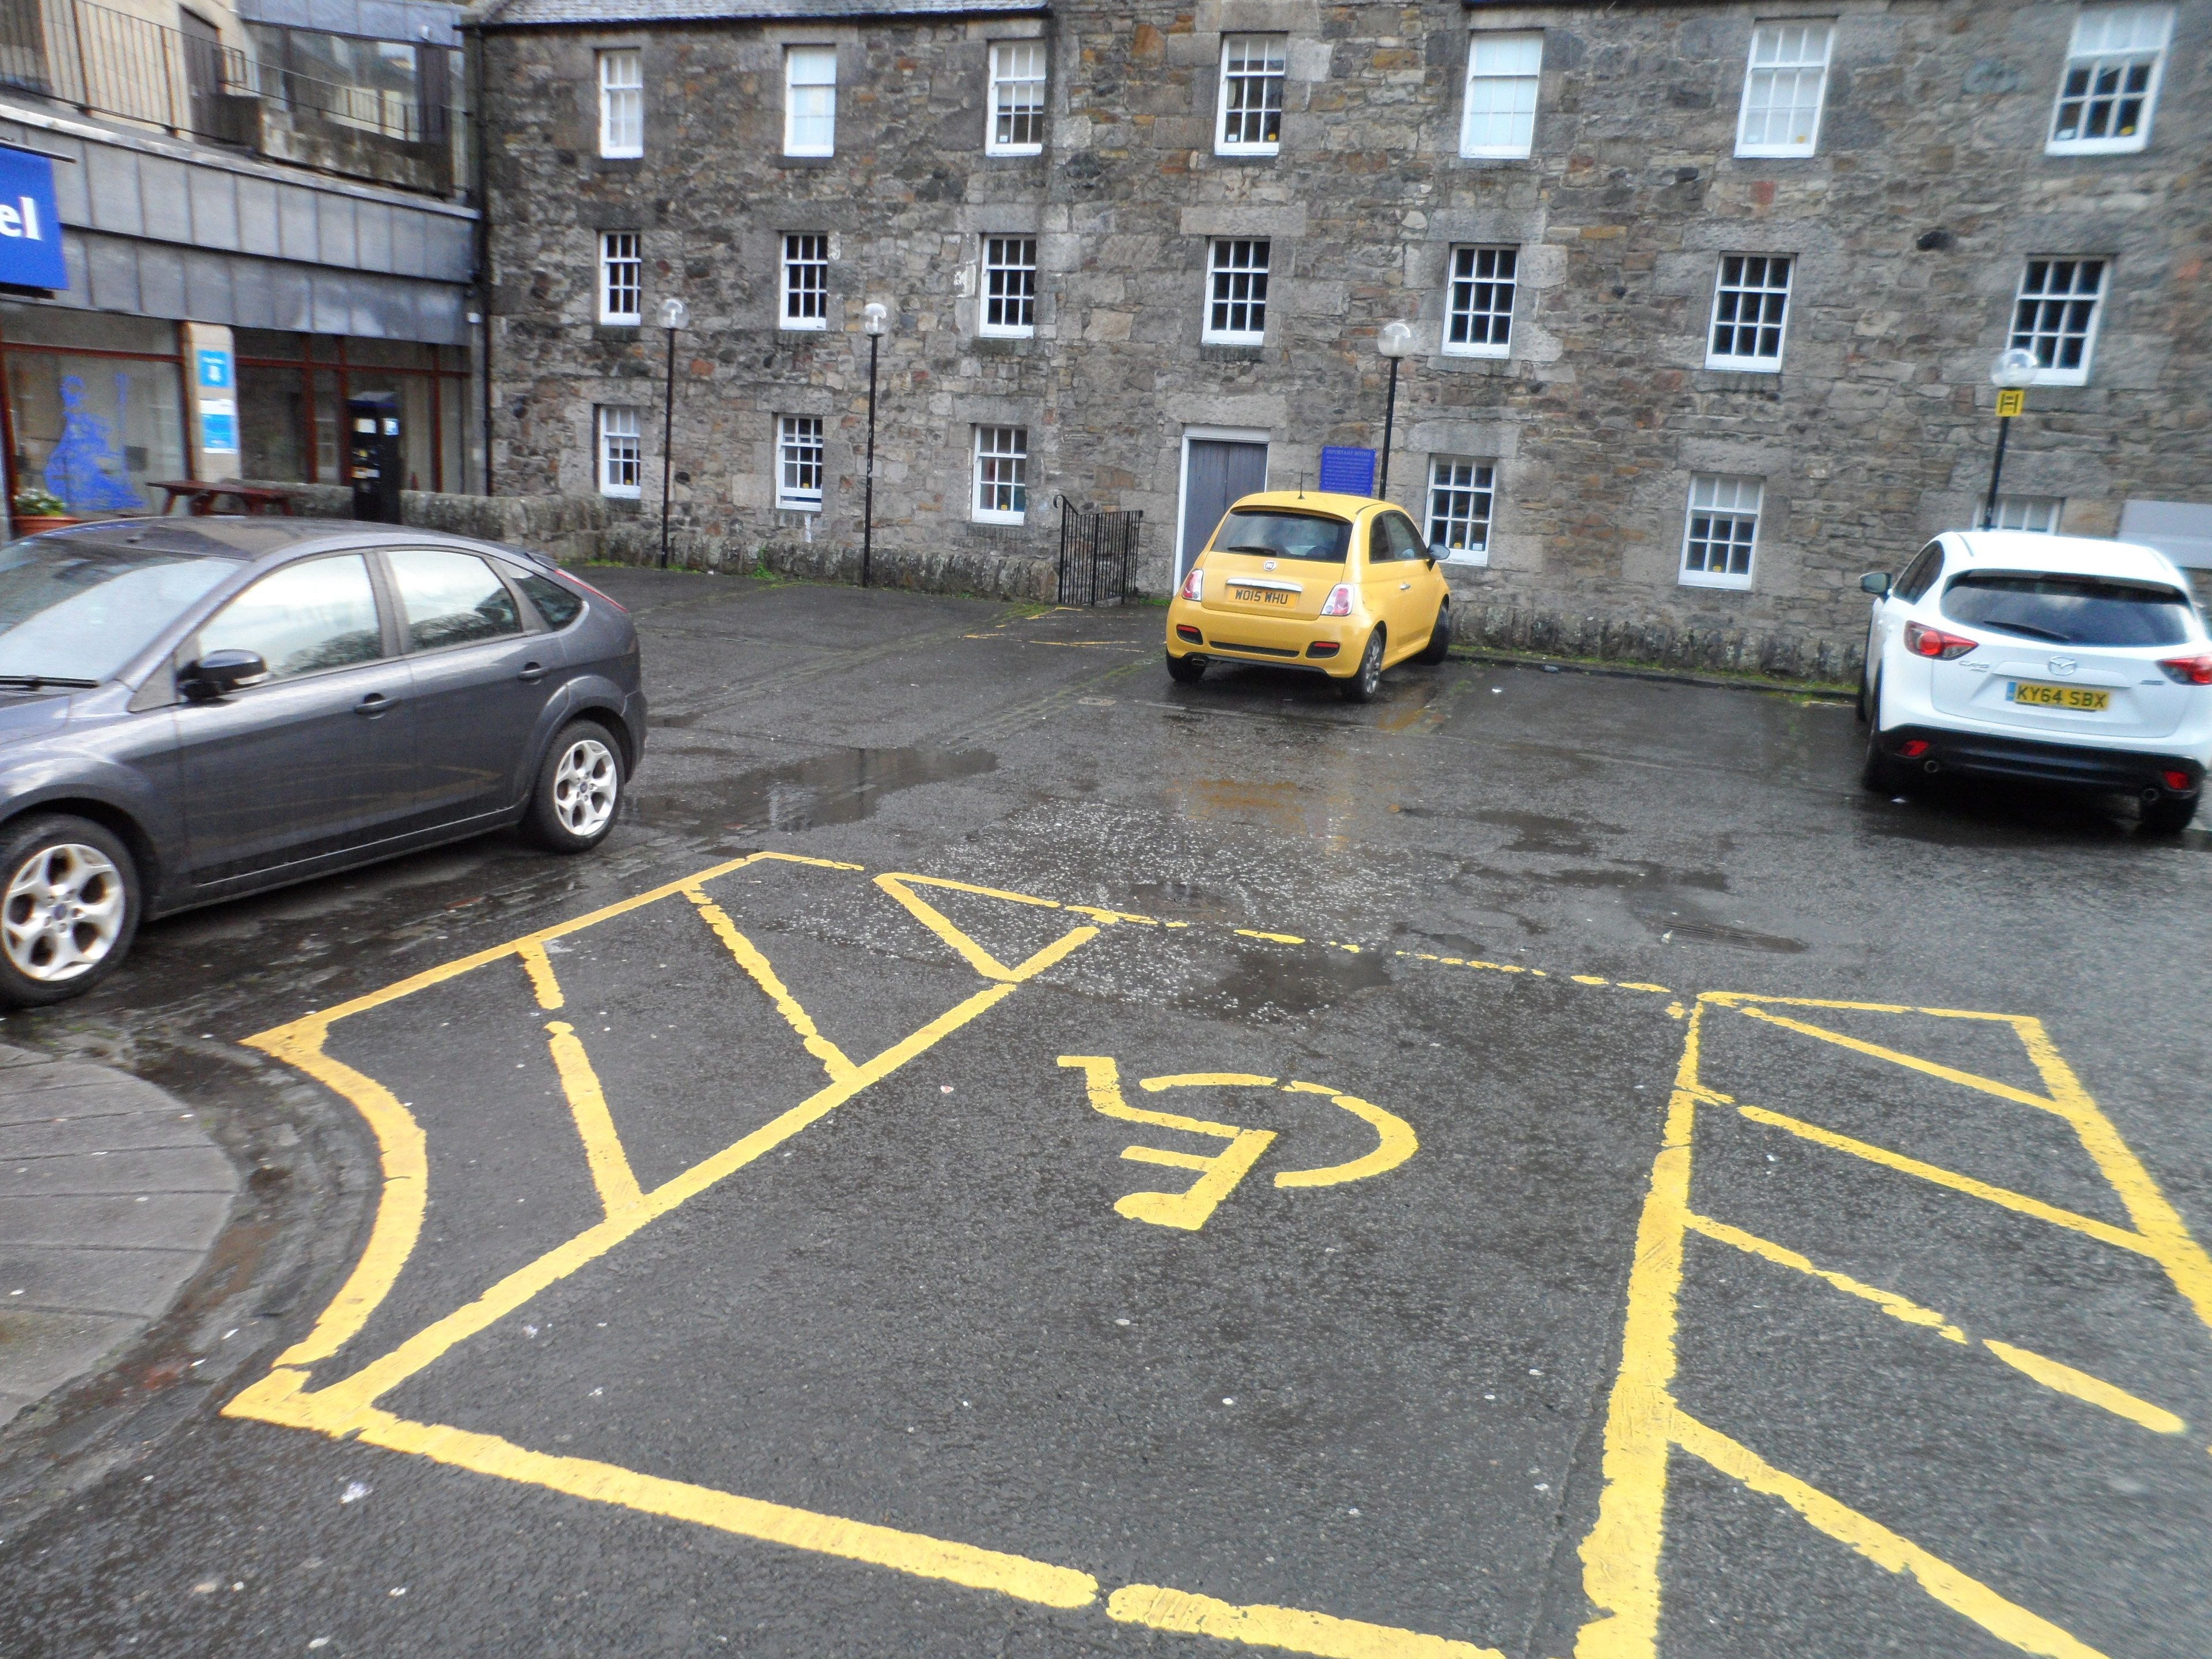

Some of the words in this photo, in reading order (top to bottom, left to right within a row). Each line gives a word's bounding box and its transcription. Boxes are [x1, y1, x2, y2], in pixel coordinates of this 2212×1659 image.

[1264, 591, 1289, 605] WHU
[2017, 685, 2062, 703] KY64
[2069, 691, 2106, 707] SBX
